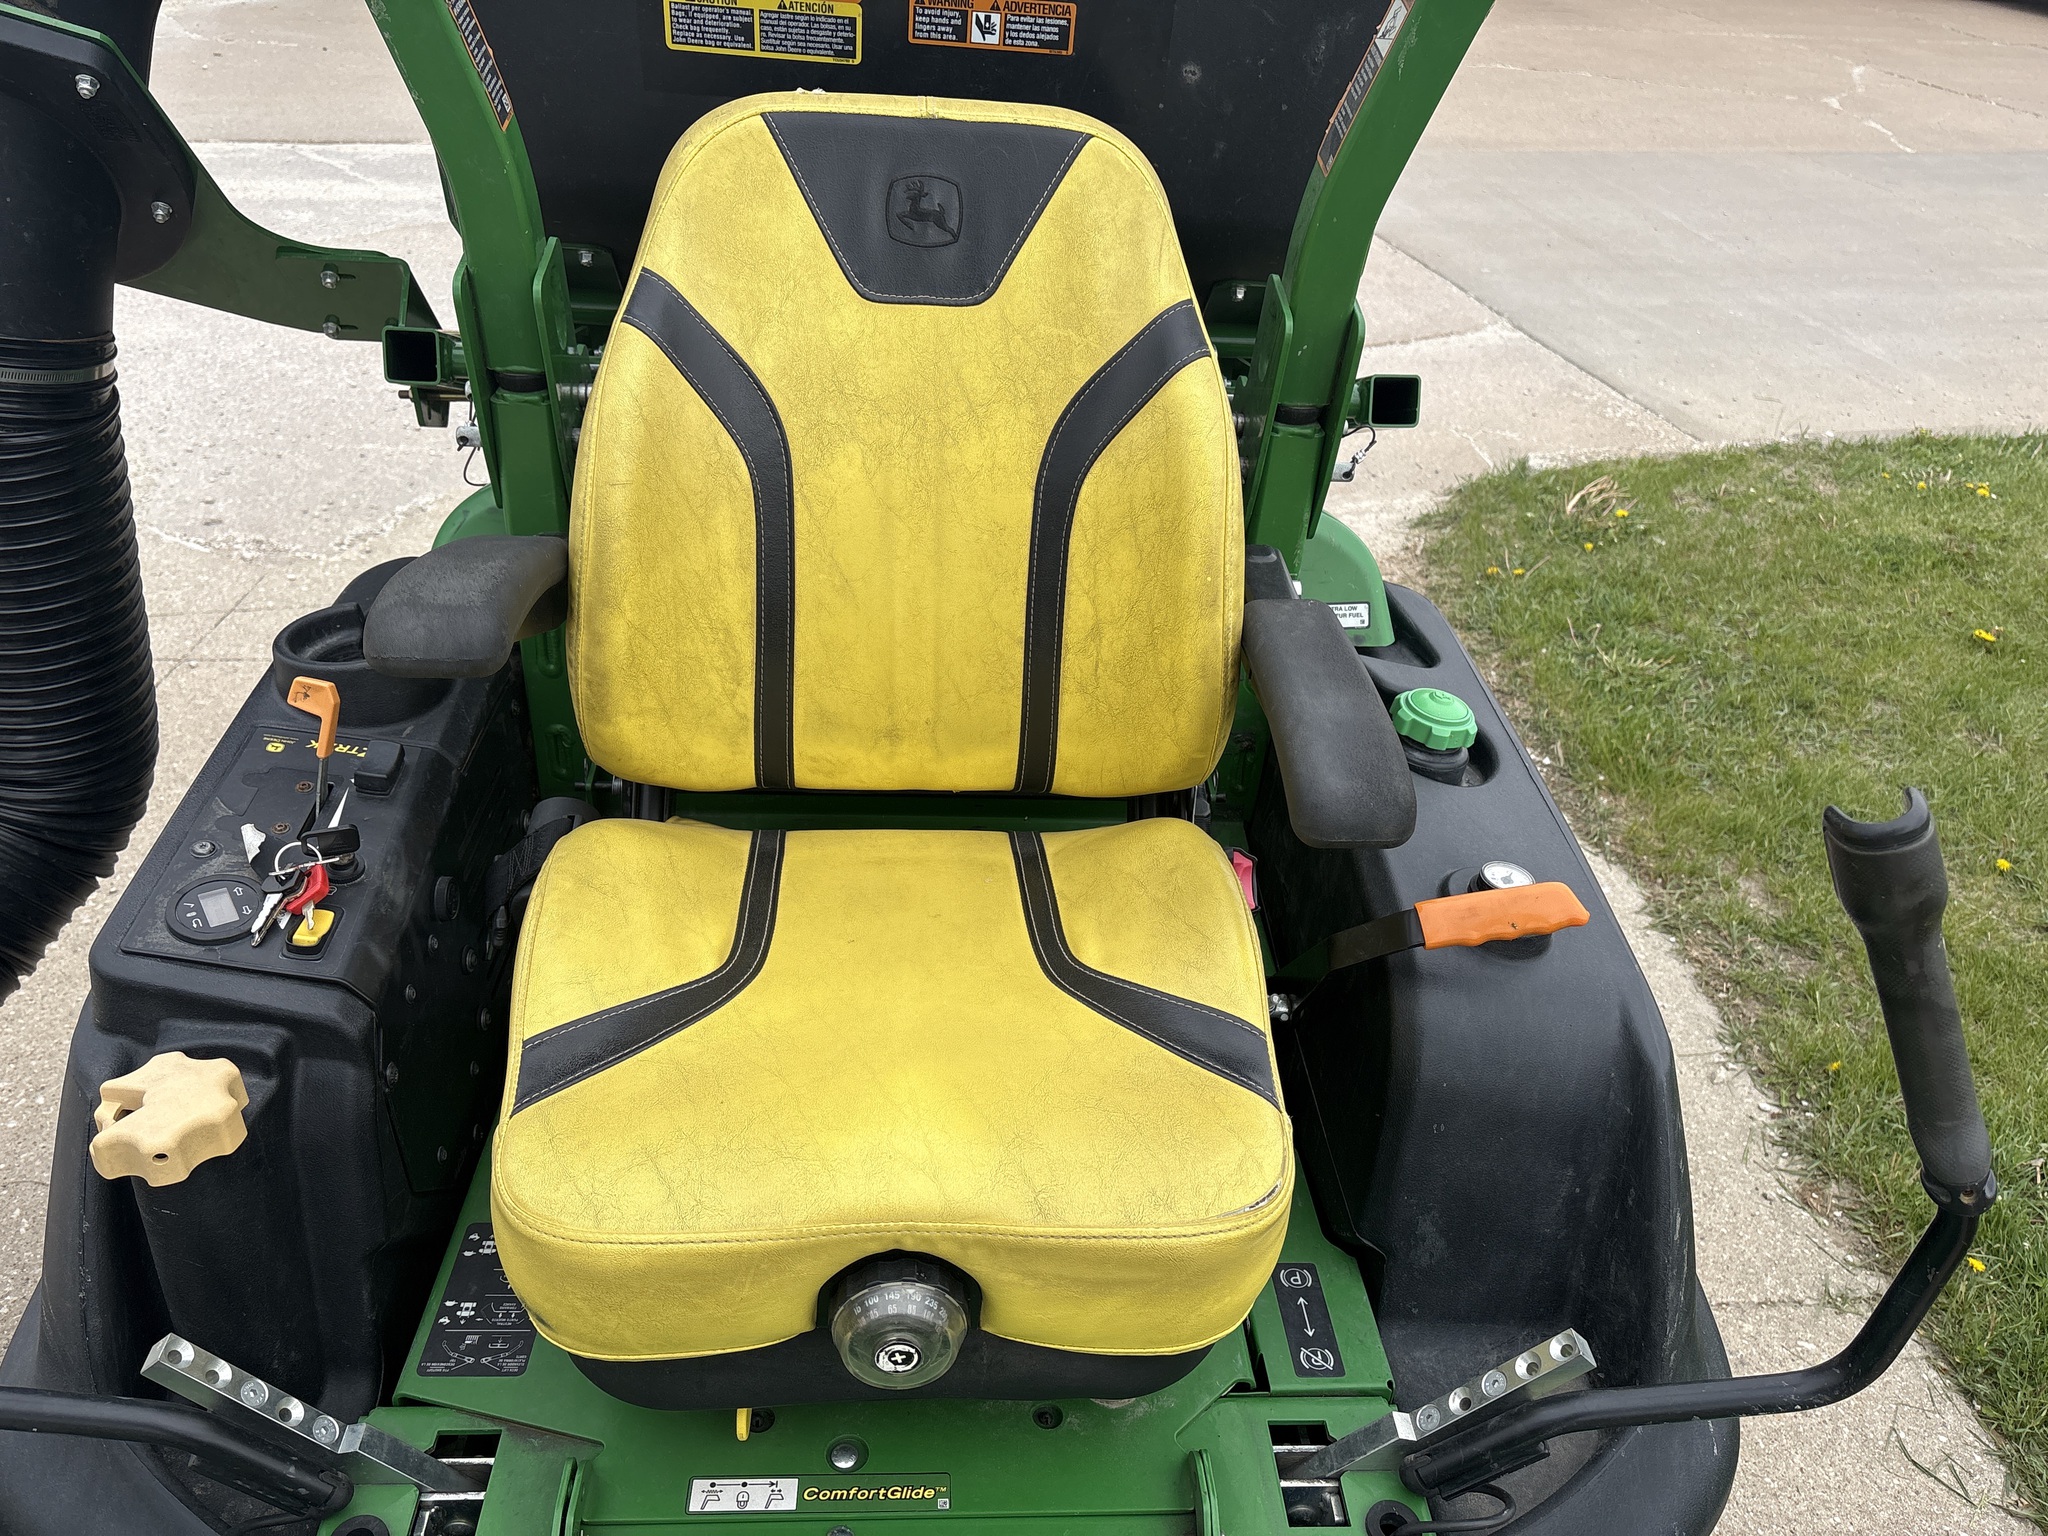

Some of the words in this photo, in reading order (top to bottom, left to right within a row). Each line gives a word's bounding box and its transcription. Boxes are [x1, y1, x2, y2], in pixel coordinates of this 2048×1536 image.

[789, 1, 833, 14] ATENCIÓN
[1003, 2, 1071, 16] ADVERTENCIA
[694, 12, 720, 20] equipped,
[942, 10, 960, 18] injury,
[705, 20, 741, 28] deterioration.
[916, 16, 929, 24] keep
[931, 17, 949, 25] hands
[1045, 18, 1069, 27] lesiones,
[915, 23, 935, 32] fingers
[811, 29, 832, 37] desgaste
[1036, 33, 1059, 41] alejados
[305, 740, 368, 757] TRK
[864, 1295, 879, 1307] 100
[884, 1291, 900, 1300] 145
[907, 1291, 922, 1302] 190
[924, 1296, 938, 1309] 235
[887, 1304, 897, 1314] 65
[907, 1304, 917, 1315] 85
